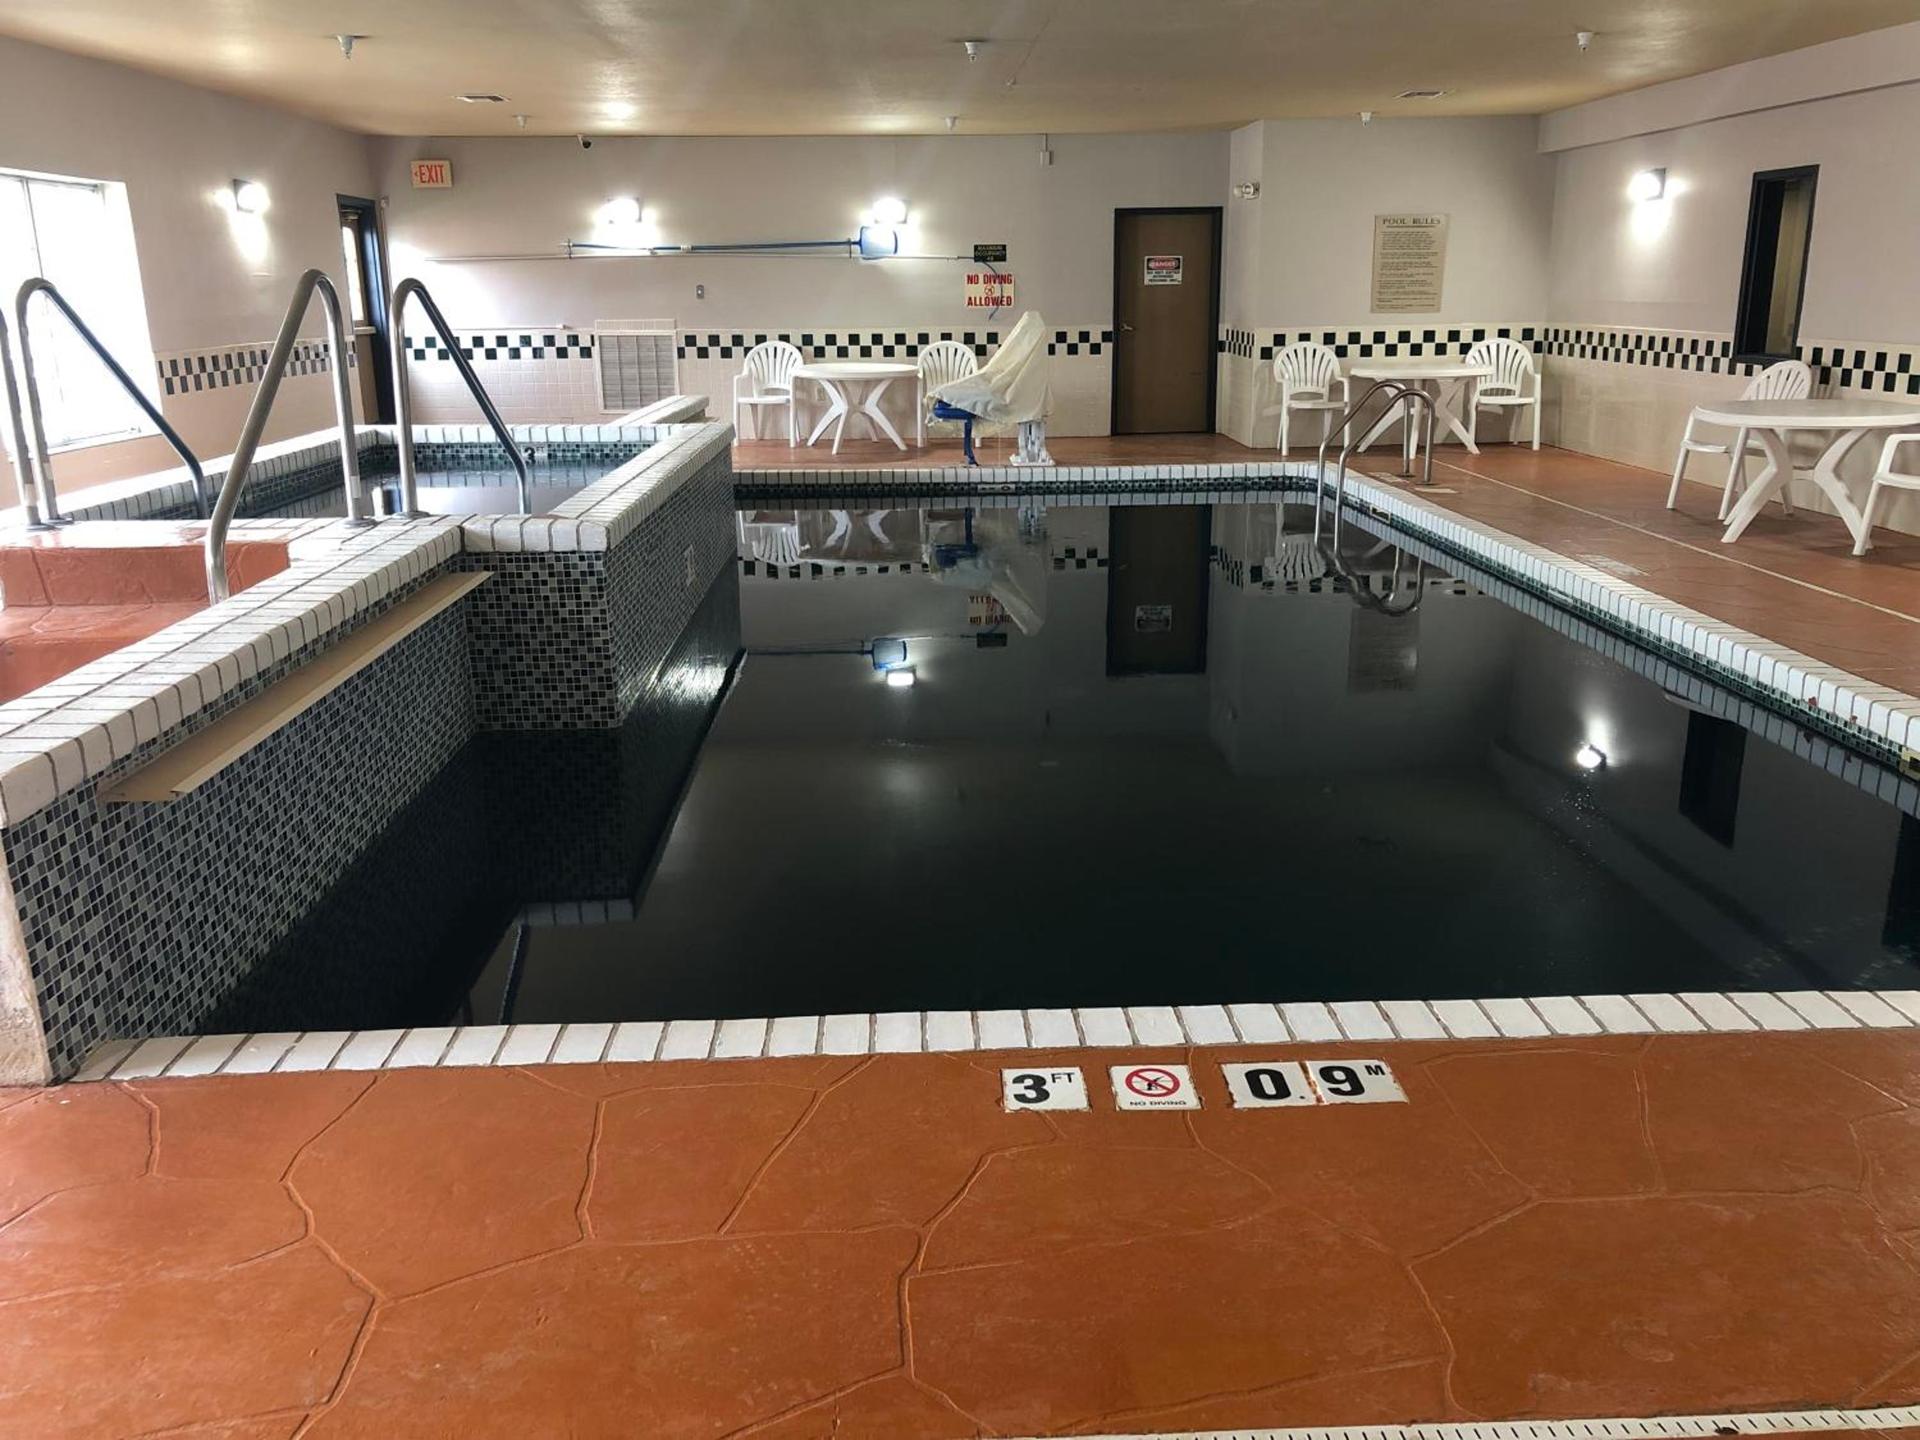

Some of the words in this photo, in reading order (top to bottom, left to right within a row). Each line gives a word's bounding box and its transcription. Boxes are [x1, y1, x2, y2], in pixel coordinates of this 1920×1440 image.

[419, 164, 444, 184] EXIT
[1383, 217, 1407, 225] POOL
[967, 274, 979, 284] NO
[983, 274, 1012, 284] DIVING
[967, 296, 1012, 306] ALLOWED
[1365, 1064, 1386, 1076] M
[1012, 1073, 1050, 1104] 3
[1051, 1072, 1075, 1084] FT
